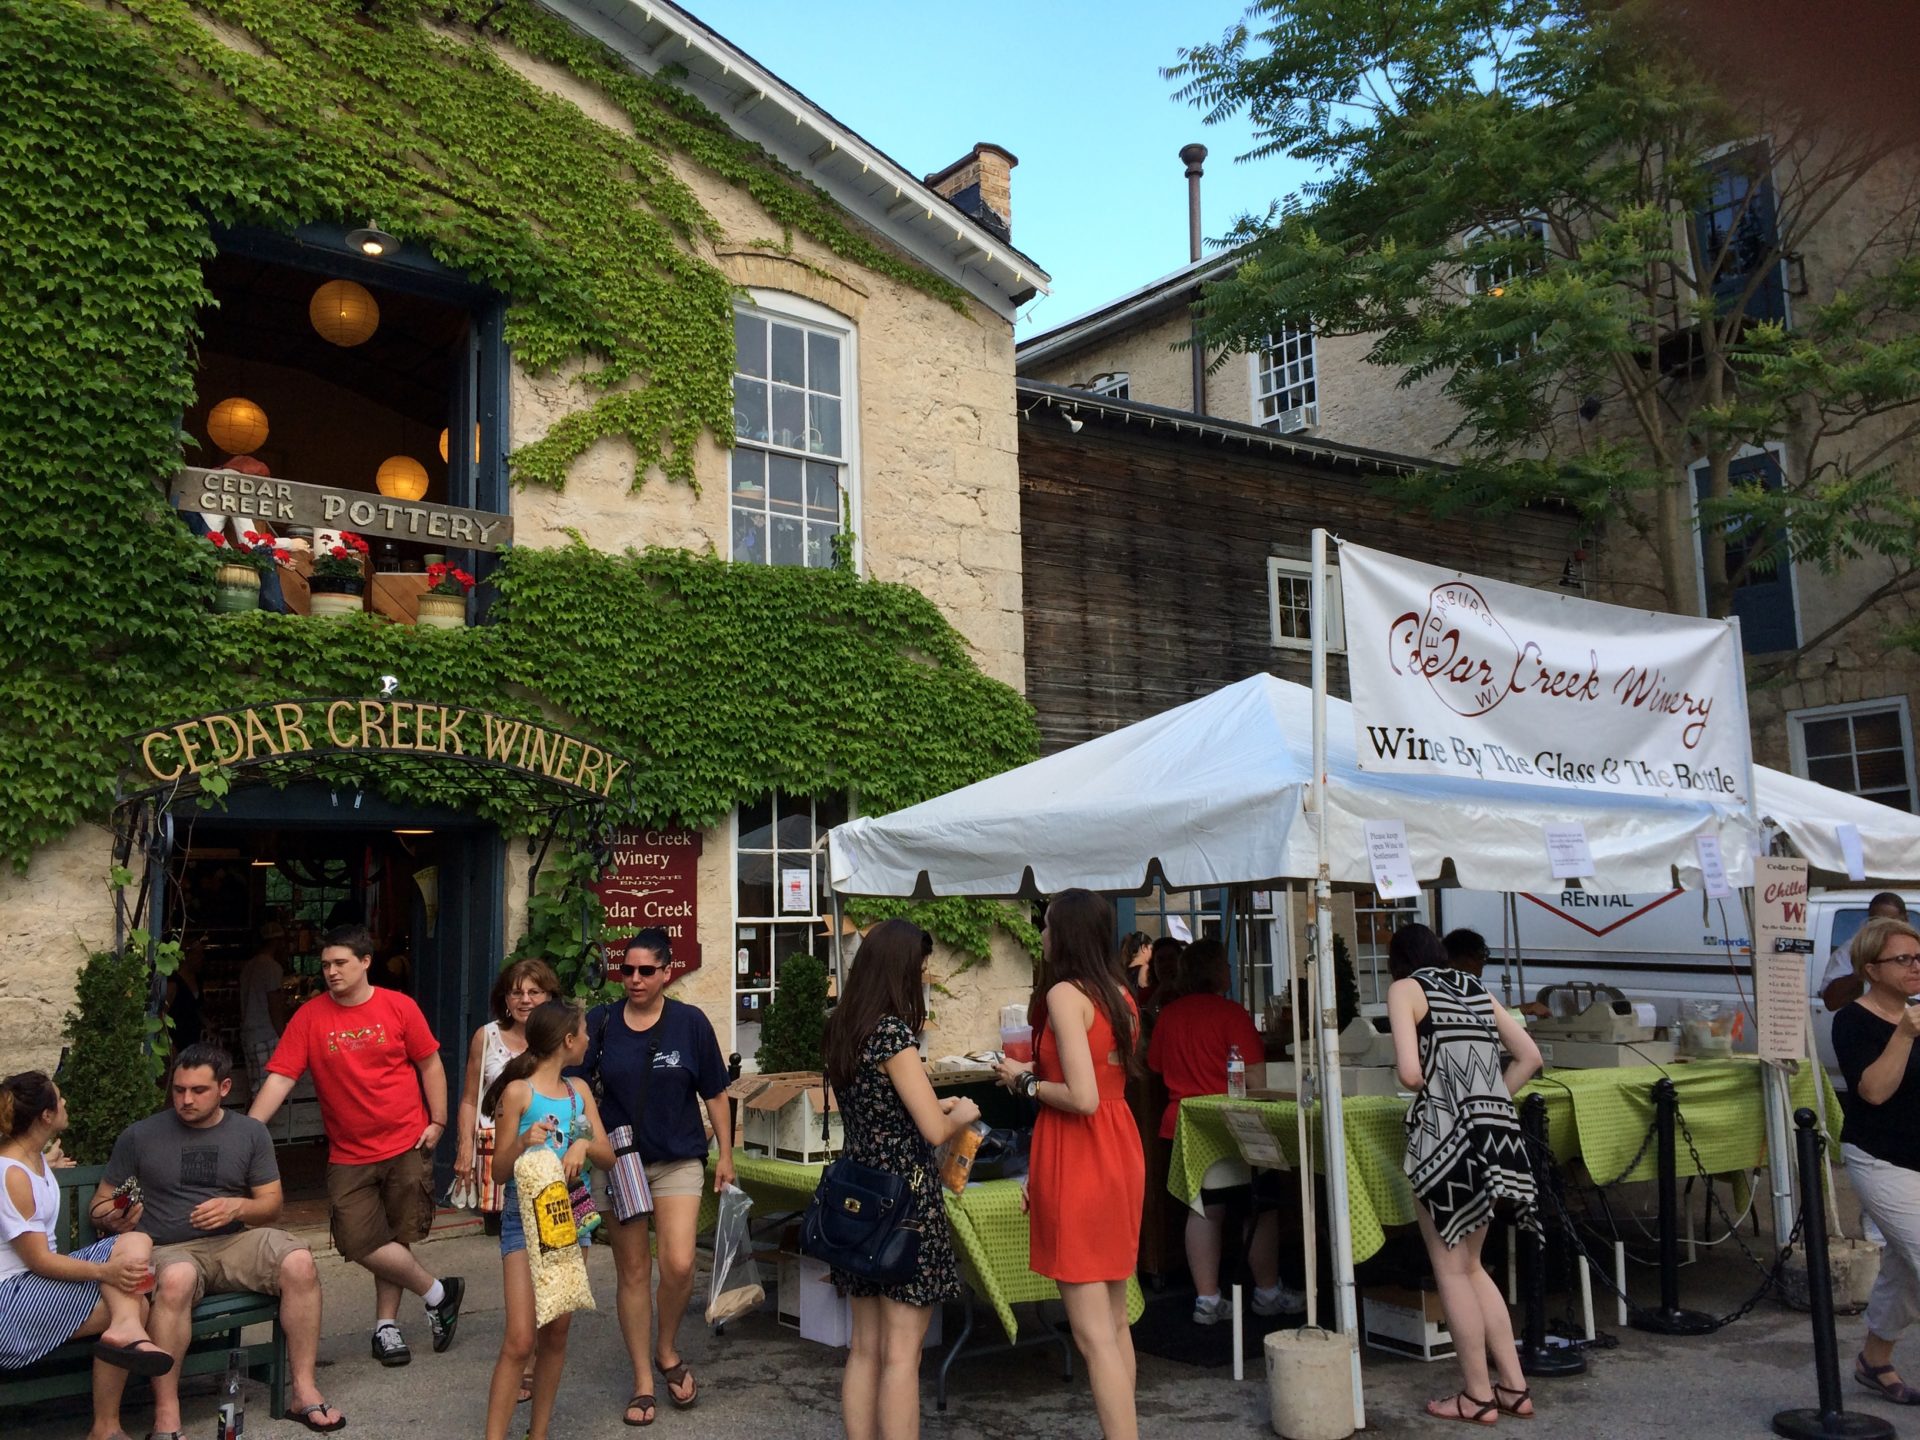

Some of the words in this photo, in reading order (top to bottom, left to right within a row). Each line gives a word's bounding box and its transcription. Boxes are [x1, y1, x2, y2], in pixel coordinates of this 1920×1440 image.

[202, 473, 293, 501] CEDAR
[199, 493, 294, 520] CREEK
[321, 494, 501, 544] POTTERY
[1388, 611, 1494, 686] Cedar
[1509, 640, 1600, 702] Creek
[1613, 665, 1714, 749] Winery
[1474, 684, 1499, 708] WI
[141, 702, 314, 781] CEDAR
[326, 700, 467, 755] CREEK
[483, 714, 631, 799] WINERY
[1366, 725, 1448, 764] Wine
[1449, 736, 1484, 780] By
[1483, 743, 1534, 775] The
[1534, 751, 1597, 784] Glass
[1601, 757, 1621, 784] &
[1624, 759, 1673, 788] The
[1673, 763, 1736, 793] Bottle
[602, 830, 639, 846] edar
[645, 830, 692, 846] Creek
[613, 850, 670, 870] Winery
[1791, 864, 1806, 872] Cree
[603, 901, 638, 918] edar
[644, 900, 693, 918] Creek
[1560, 890, 1634, 908] RENTAL
